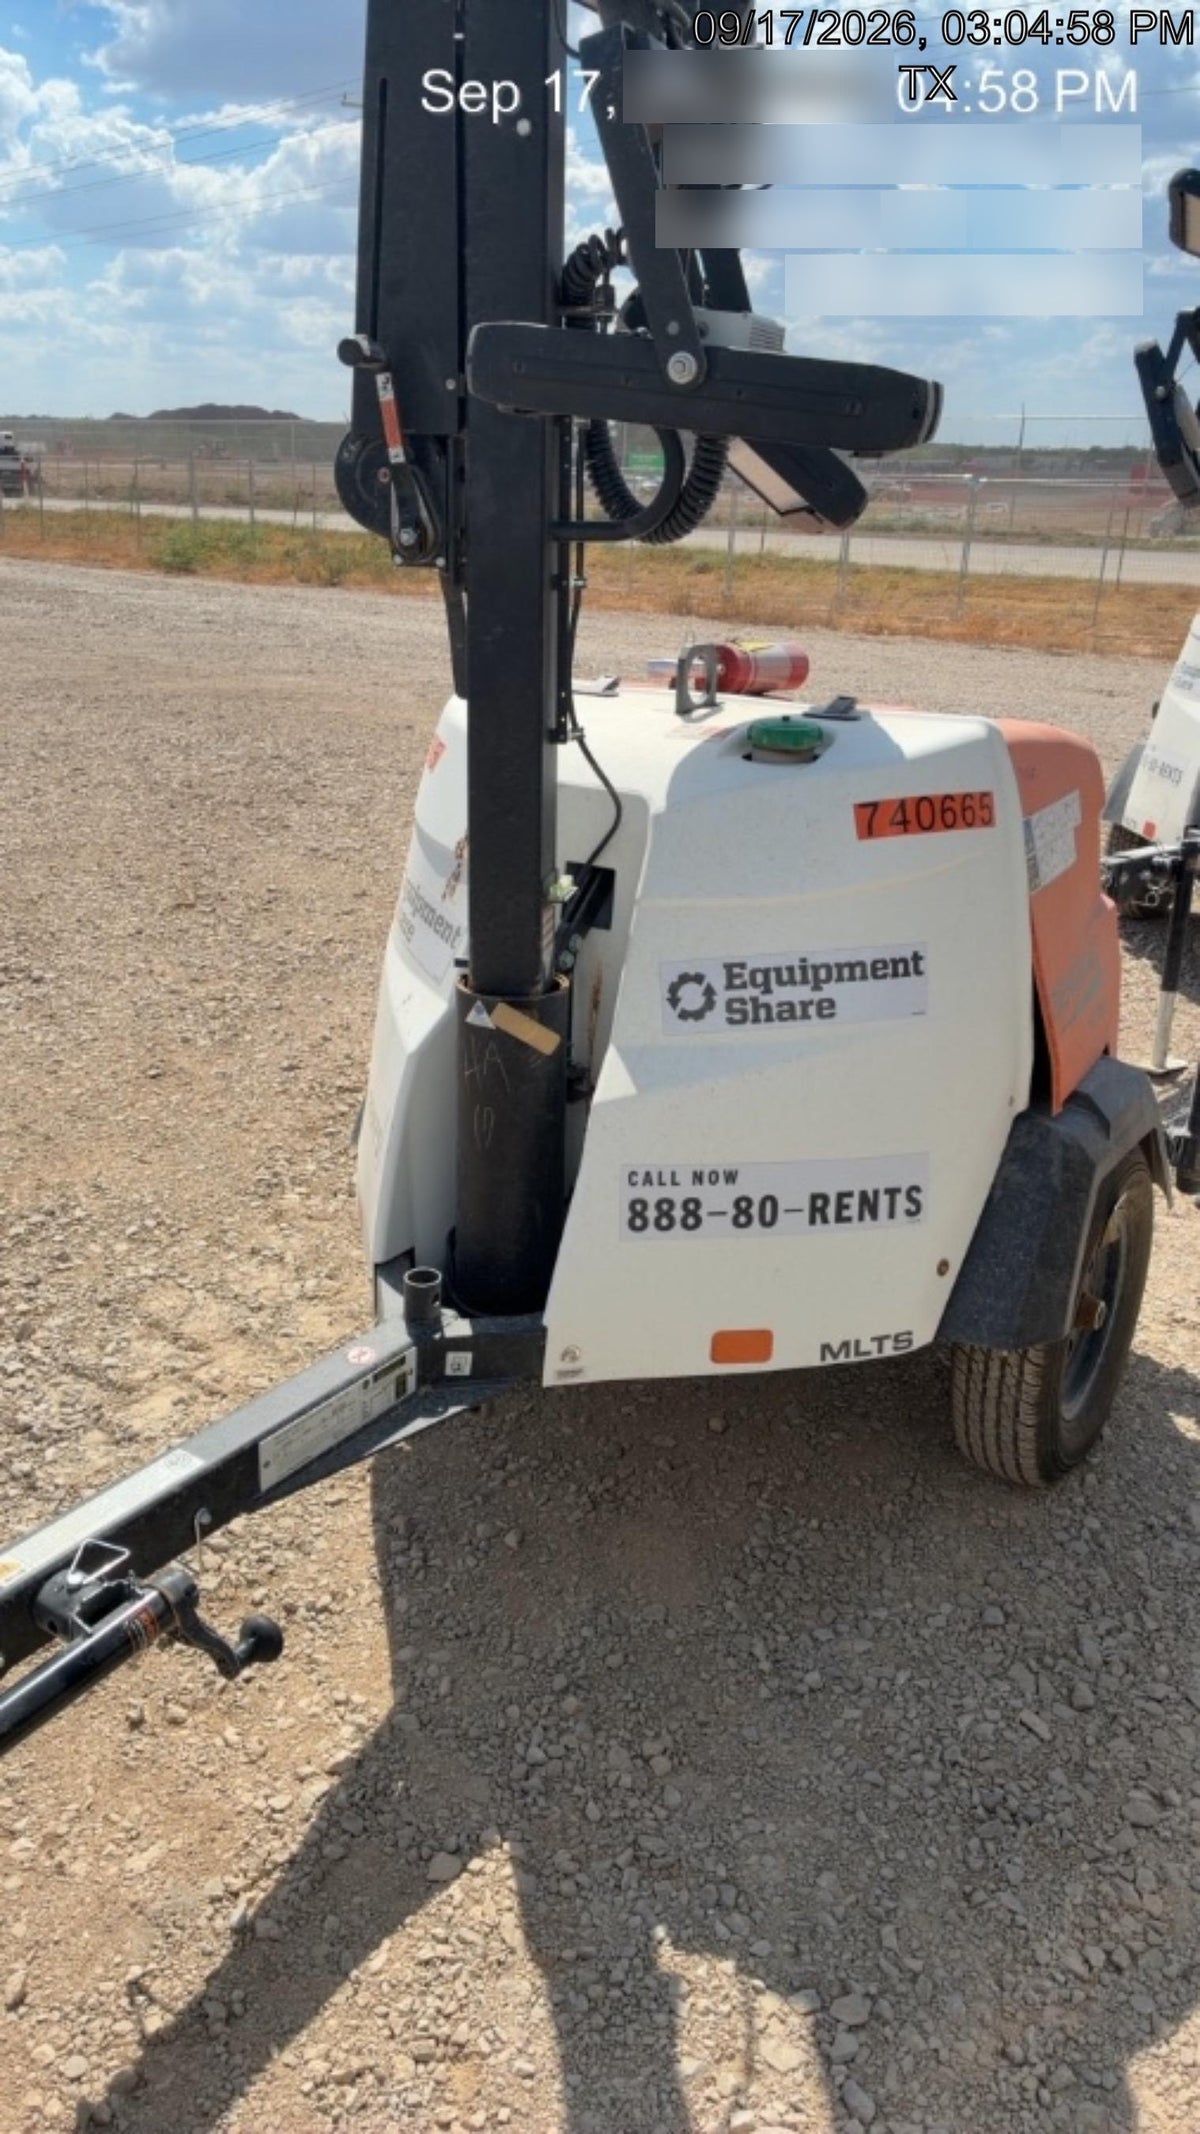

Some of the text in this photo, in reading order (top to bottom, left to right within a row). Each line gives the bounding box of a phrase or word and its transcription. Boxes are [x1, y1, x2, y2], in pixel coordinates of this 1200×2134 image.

[855, 791, 994, 837] 740665
[722, 950, 925, 995] Equipment
[724, 996, 837, 1026] Share
[627, 1168, 740, 1188] CALL NOW
[626, 1185, 924, 1233] 888-80-RENTS
[818, 1330, 915, 1363] MLTS
